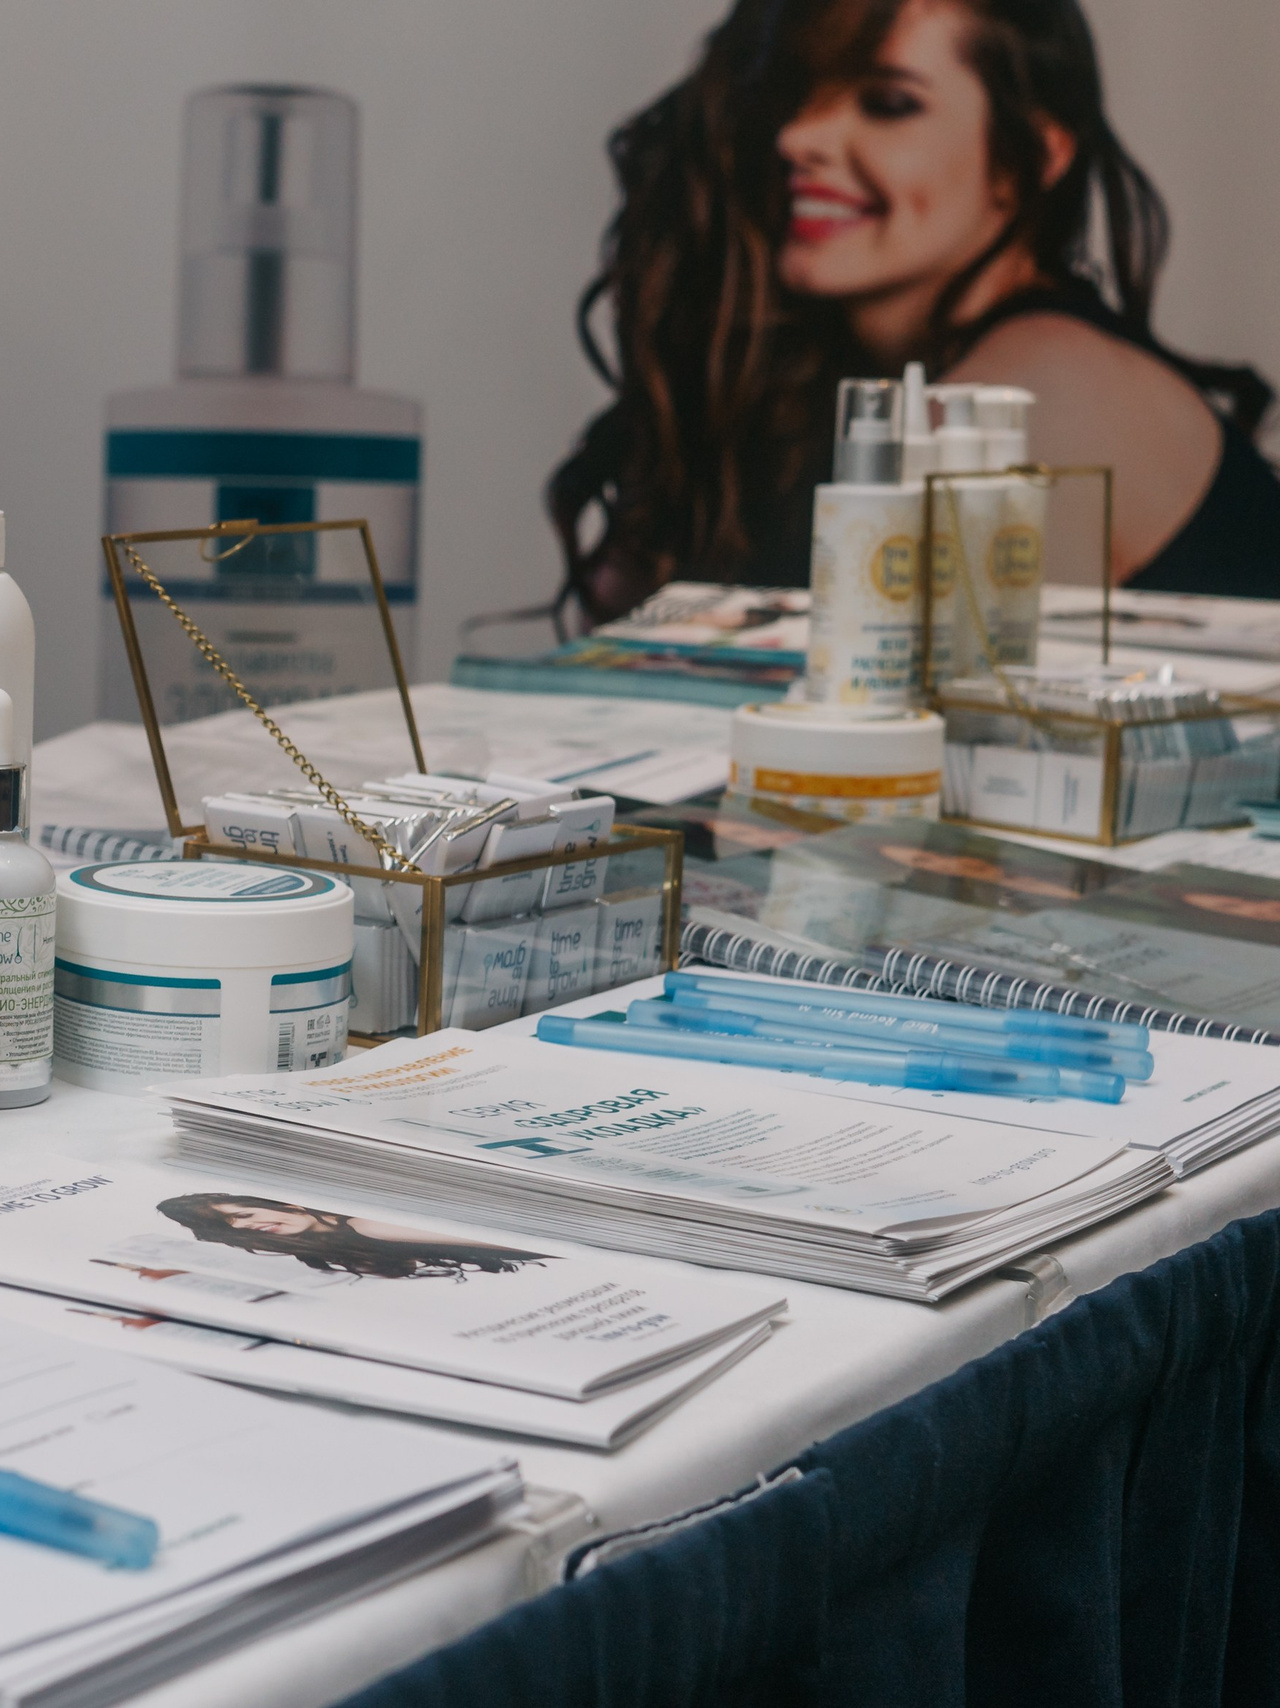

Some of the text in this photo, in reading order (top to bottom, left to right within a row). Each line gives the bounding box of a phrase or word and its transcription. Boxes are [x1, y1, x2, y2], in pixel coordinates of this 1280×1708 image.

[243, 828, 259, 843] to
[551, 931, 582, 955] time
[615, 916, 644, 943] time
[493, 940, 527, 971] grow
[549, 959, 560, 974] to
[609, 954, 640, 985] grow
[487, 984, 520, 1008] time
[547, 969, 581, 1001] grow
[847, 1012, 898, 1027] Round
[355, 1045, 474, 1084] НАПРАВЛЕНИЕ
[341, 1066, 462, 1094] ТРИХОЛОГИИ!
[448, 1099, 547, 1120] СЕРИЯ
[515, 1087, 670, 1130] «ЗДОРОВАЯ
[556, 1105, 708, 1142] УКЛАДКА»
[23, 1188, 61, 1206] TO
[51, 1175, 111, 1198] GROW
